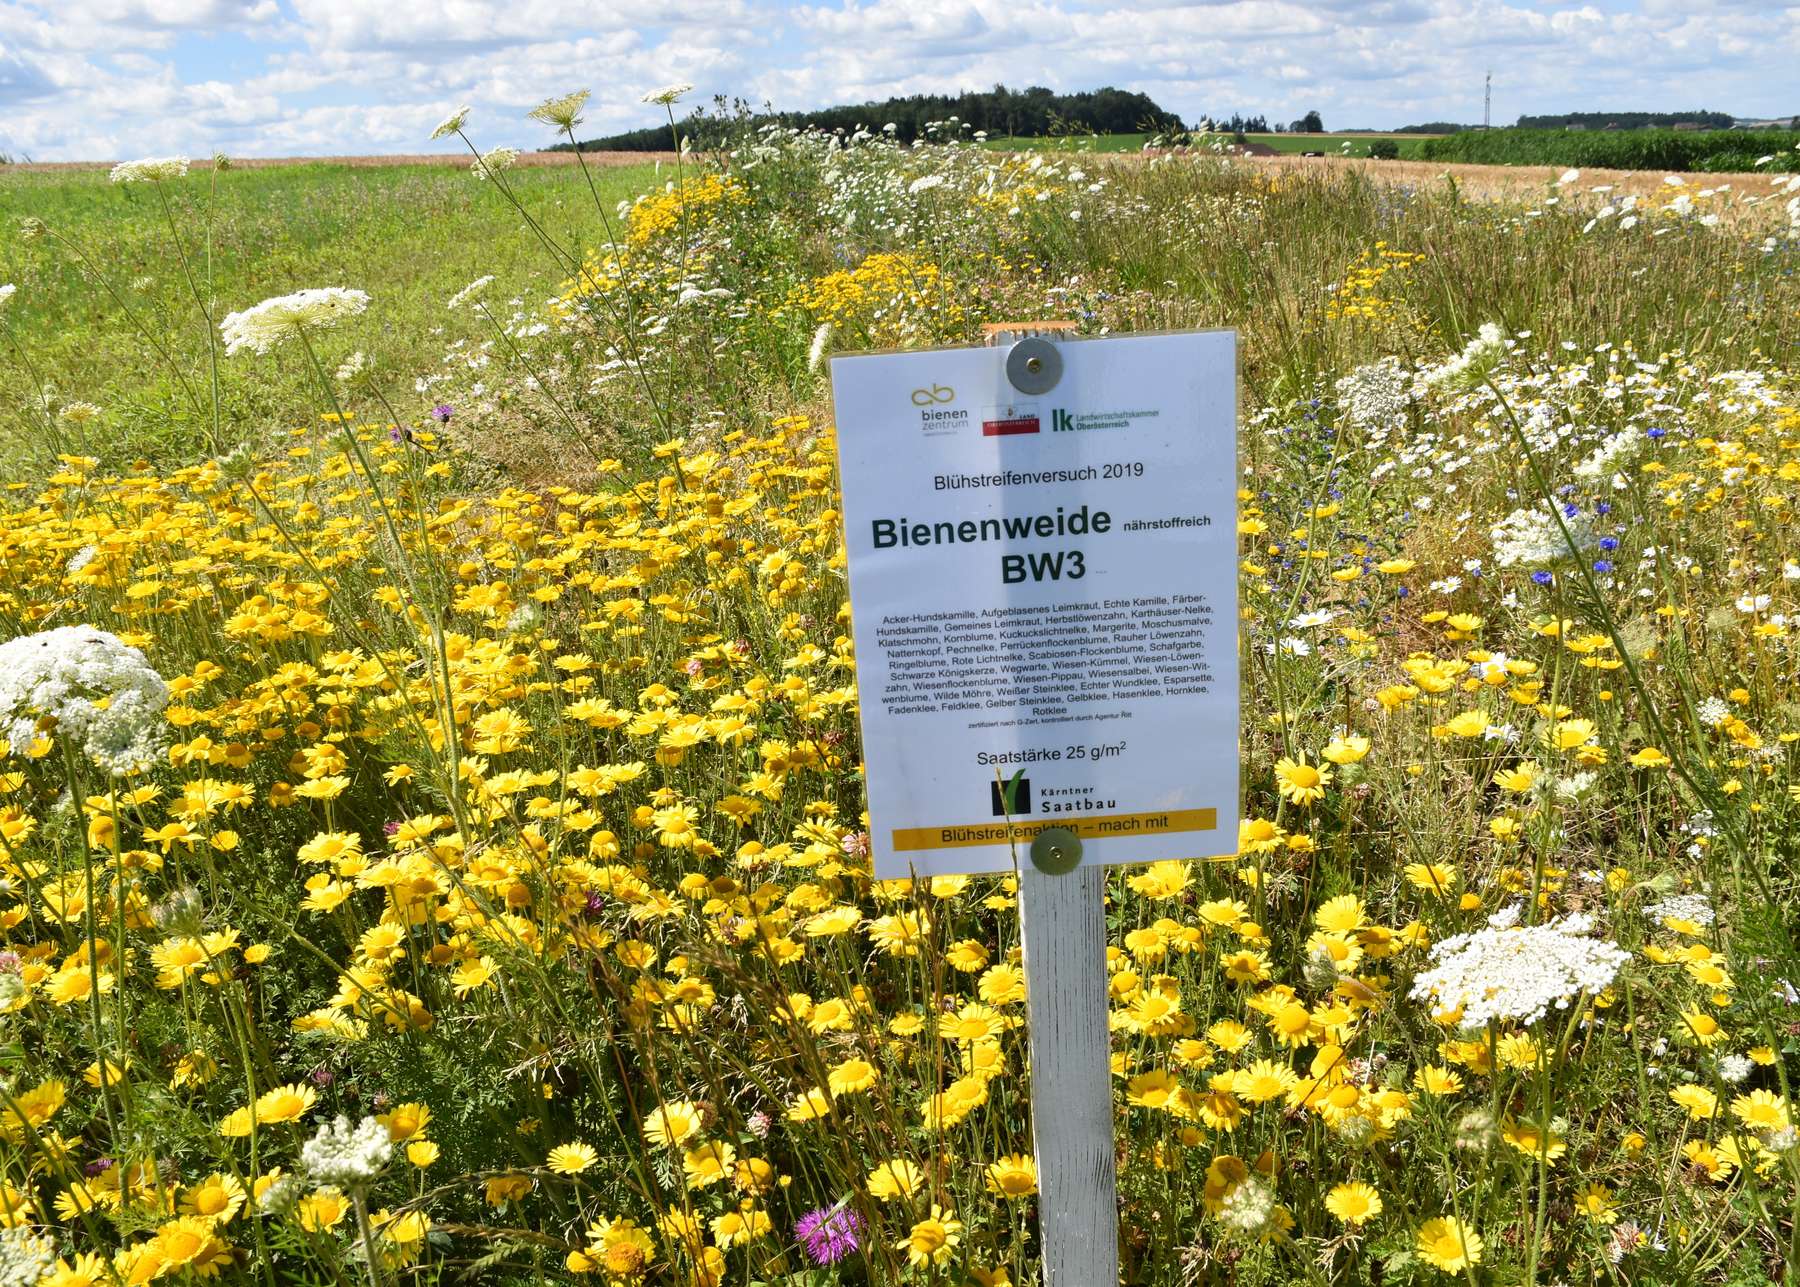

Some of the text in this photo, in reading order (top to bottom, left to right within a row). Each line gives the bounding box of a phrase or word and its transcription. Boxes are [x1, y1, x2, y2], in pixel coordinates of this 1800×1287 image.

[922, 409, 968, 420] bienen
[922, 420, 968, 430] zentrum
[934, 462, 1144, 491] Blühstreifenversuch 2019
[872, 505, 1211, 549] Bienenweide nährstoffreich
[1002, 551, 1086, 584] BW3
[876, 606, 1213, 636] Hundskamille, Gemeines Leimkraut, Herbstlöwenzahn, Karthäuser-Nelke,
[883, 595, 1206, 624] Acker-Hundskamille, Aufgeblasenes Leimkraut, Echte Kamille, Färber-
[878, 618, 1212, 648] Klatschmohn, Kornblume, Kuckuckslichtnelke, Margerite, Moschusmalve,
[887, 647, 943, 659] Natternkopf,
[946, 643, 997, 654] Pechnelke,
[1114, 634, 1147, 643] Rauher
[1150, 630, 1205, 640] Löwenzahn,
[889, 641, 1204, 670] Ringelblume, Rote Lichtnelke, Scabiosen-Flockenblume, Schafgarbe,
[890, 653, 1204, 681] Schwarze Königskerze, Wegwarte, Wiesen-Kümmel, Wiesen-Löwen-
[882, 675, 1215, 704] wenblume, Wilde Möhre, Weißer Steinklee, Echter Wundklee, Esparsette,
[885, 664, 1210, 693] zahn, Wiesenflockenblume, Wiesen-Pippau, Wiesensalbei, Wiesen-Wit-
[888, 686, 1209, 715] Fadenklee, Feldklee, Gelber Steinklee, Gelbklee, Hasenklee, Hornklee,
[1033, 707, 1067, 716] Rotklee
[1041, 716, 1073, 724] kontrolliert
[1095, 713, 1119, 721] Agentur
[977, 749, 1062, 766] Saatstärke
[1066, 746, 1086, 759] 25
[1041, 786, 1095, 796] Kärntner
[1042, 798, 1116, 813] Saatbau
[1099, 817, 1140, 831] mach
[1146, 816, 1168, 827] mit
